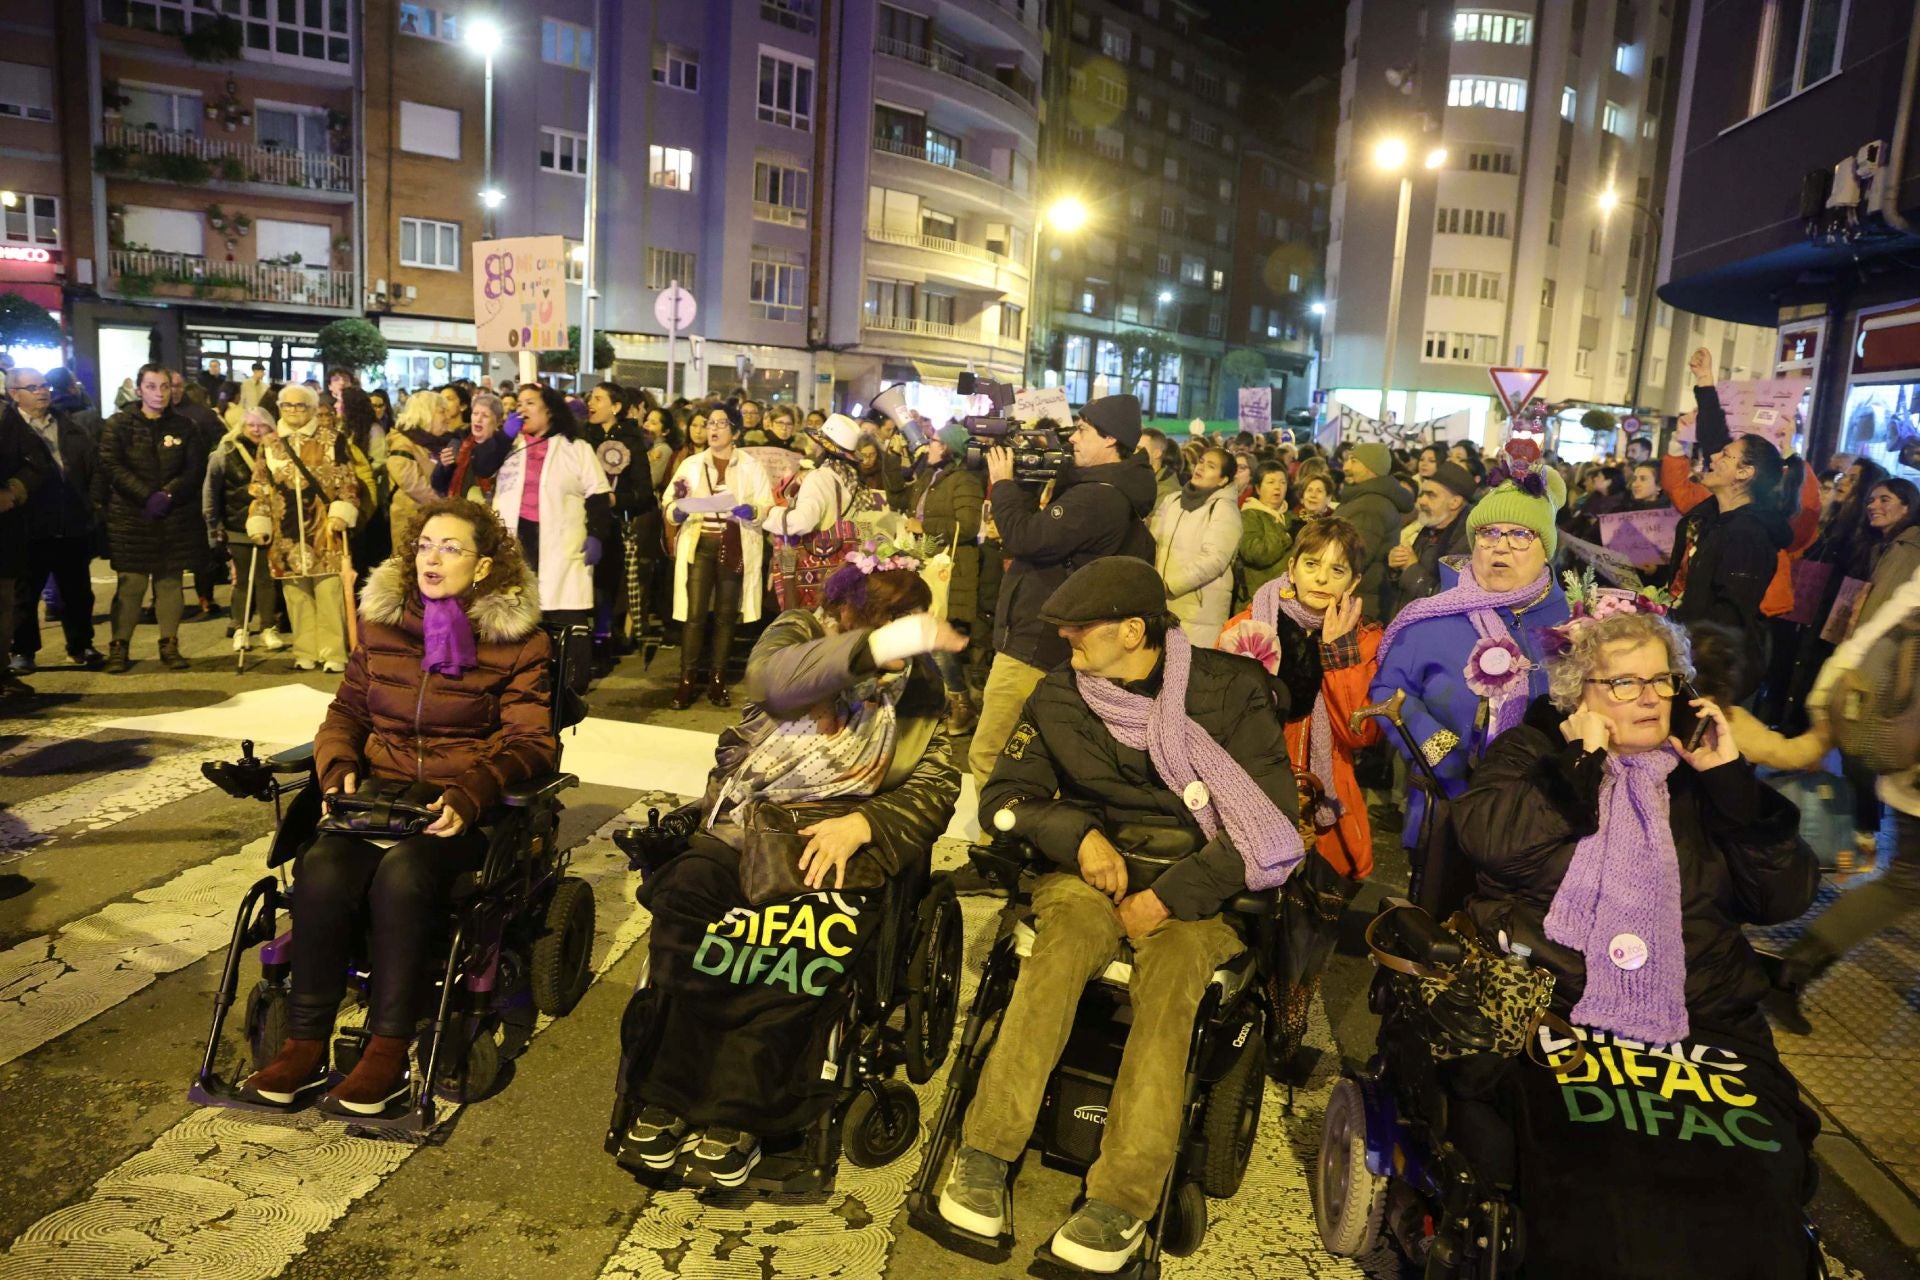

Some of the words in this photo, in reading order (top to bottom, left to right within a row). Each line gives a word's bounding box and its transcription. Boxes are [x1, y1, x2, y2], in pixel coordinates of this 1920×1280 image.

[692, 933, 845, 997] DIFAC
[1547, 1046, 1758, 1107] DIFAC
[1074, 1109, 1107, 1125] QUICK
[1561, 1085, 1782, 1152] DIFAC
